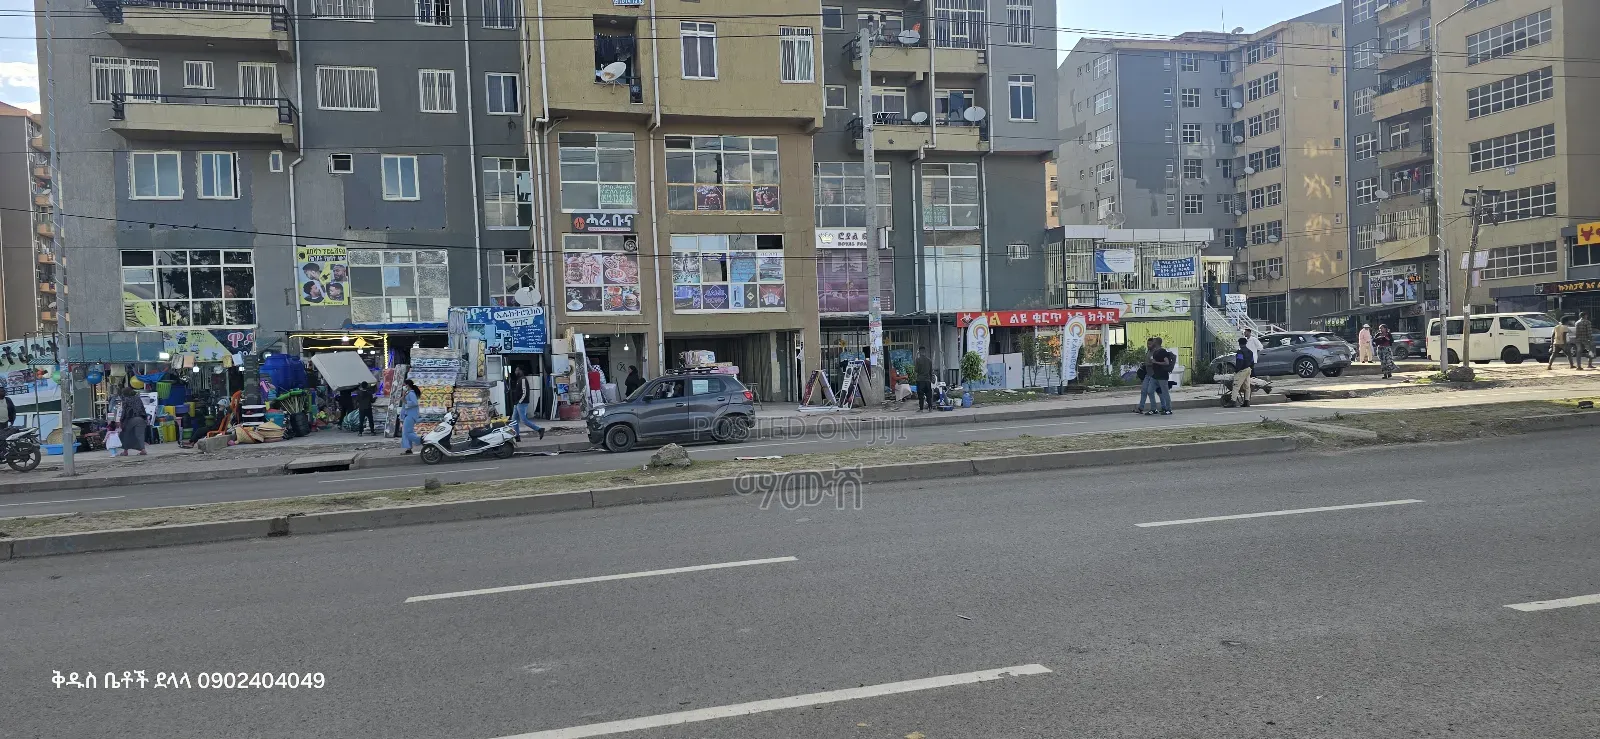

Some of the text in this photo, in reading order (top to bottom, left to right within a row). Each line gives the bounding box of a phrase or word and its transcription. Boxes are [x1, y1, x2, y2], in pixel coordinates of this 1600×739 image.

[612, 213, 634, 226] ቡና
[1009, 313, 1028, 324] ልዩ
[1032, 312, 1062, 324] ቁርጥ
